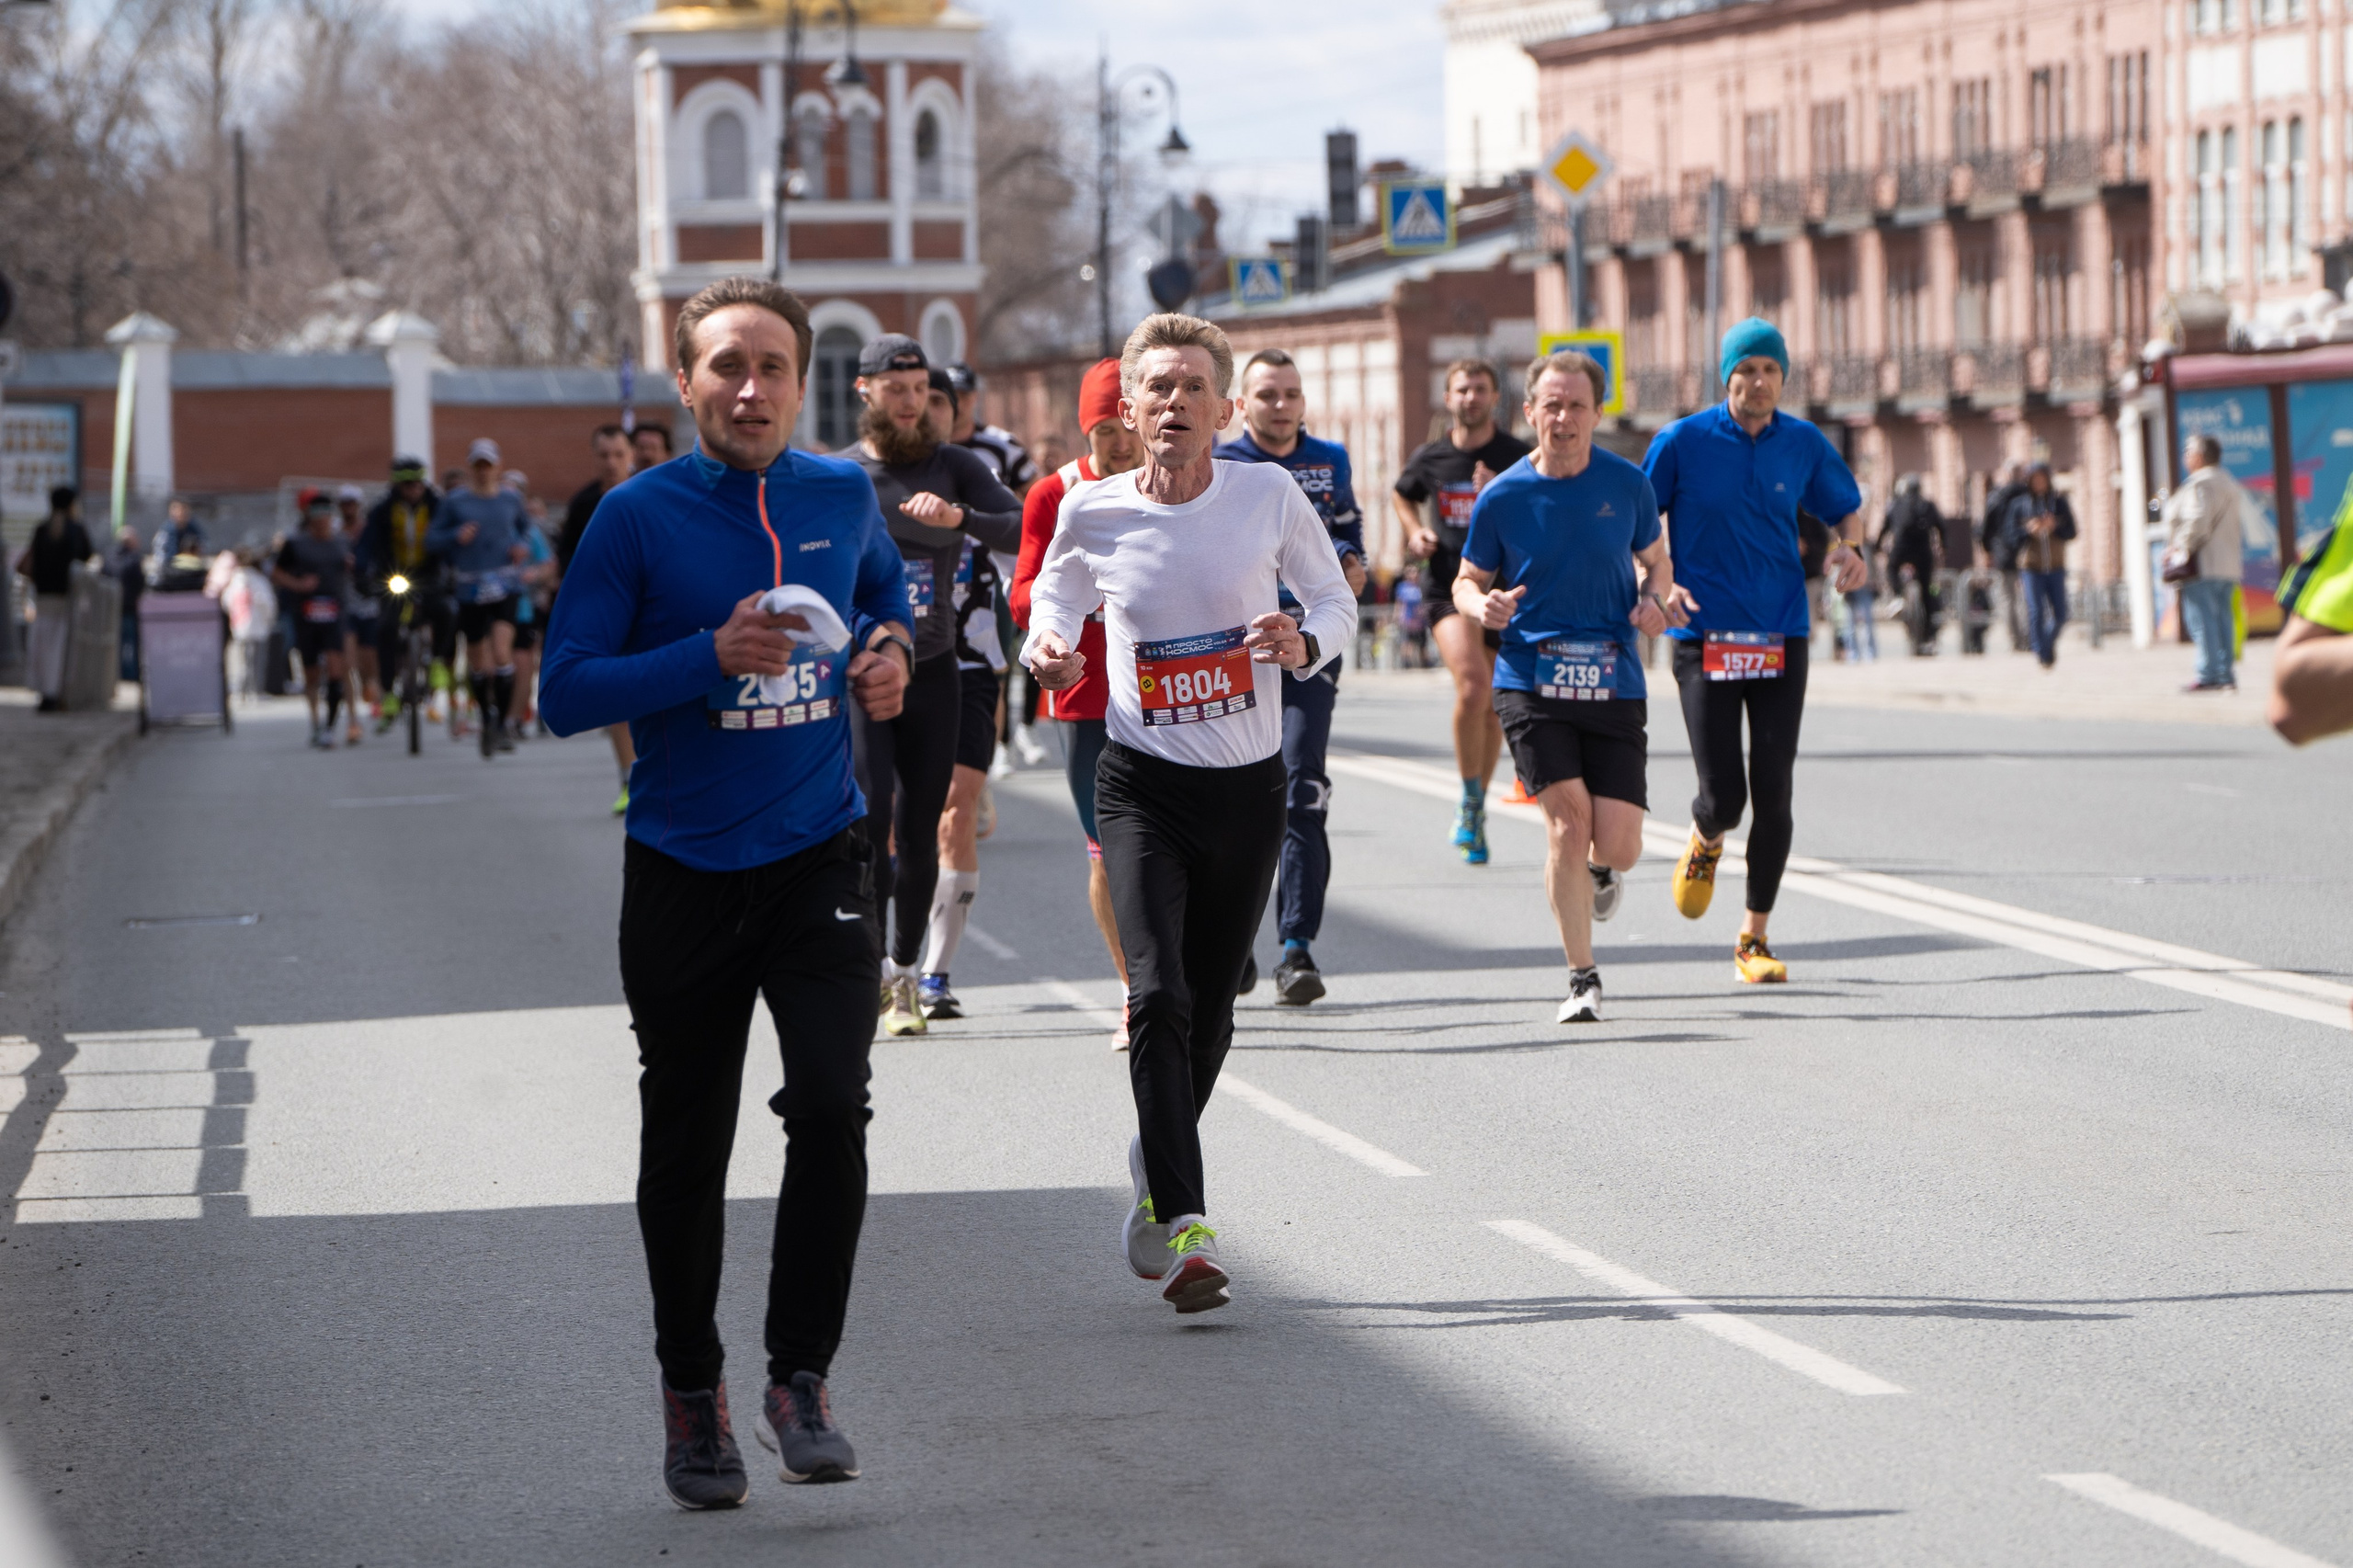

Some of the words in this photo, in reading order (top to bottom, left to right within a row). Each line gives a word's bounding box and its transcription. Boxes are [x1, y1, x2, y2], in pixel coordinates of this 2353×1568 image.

[1165, 643, 1214, 655] КОСМОС
[1173, 638, 1213, 649] ПРОСТО
[1722, 652, 1766, 671] 1577
[1160, 666, 1232, 704] 1804
[1552, 663, 1600, 688] 2139
